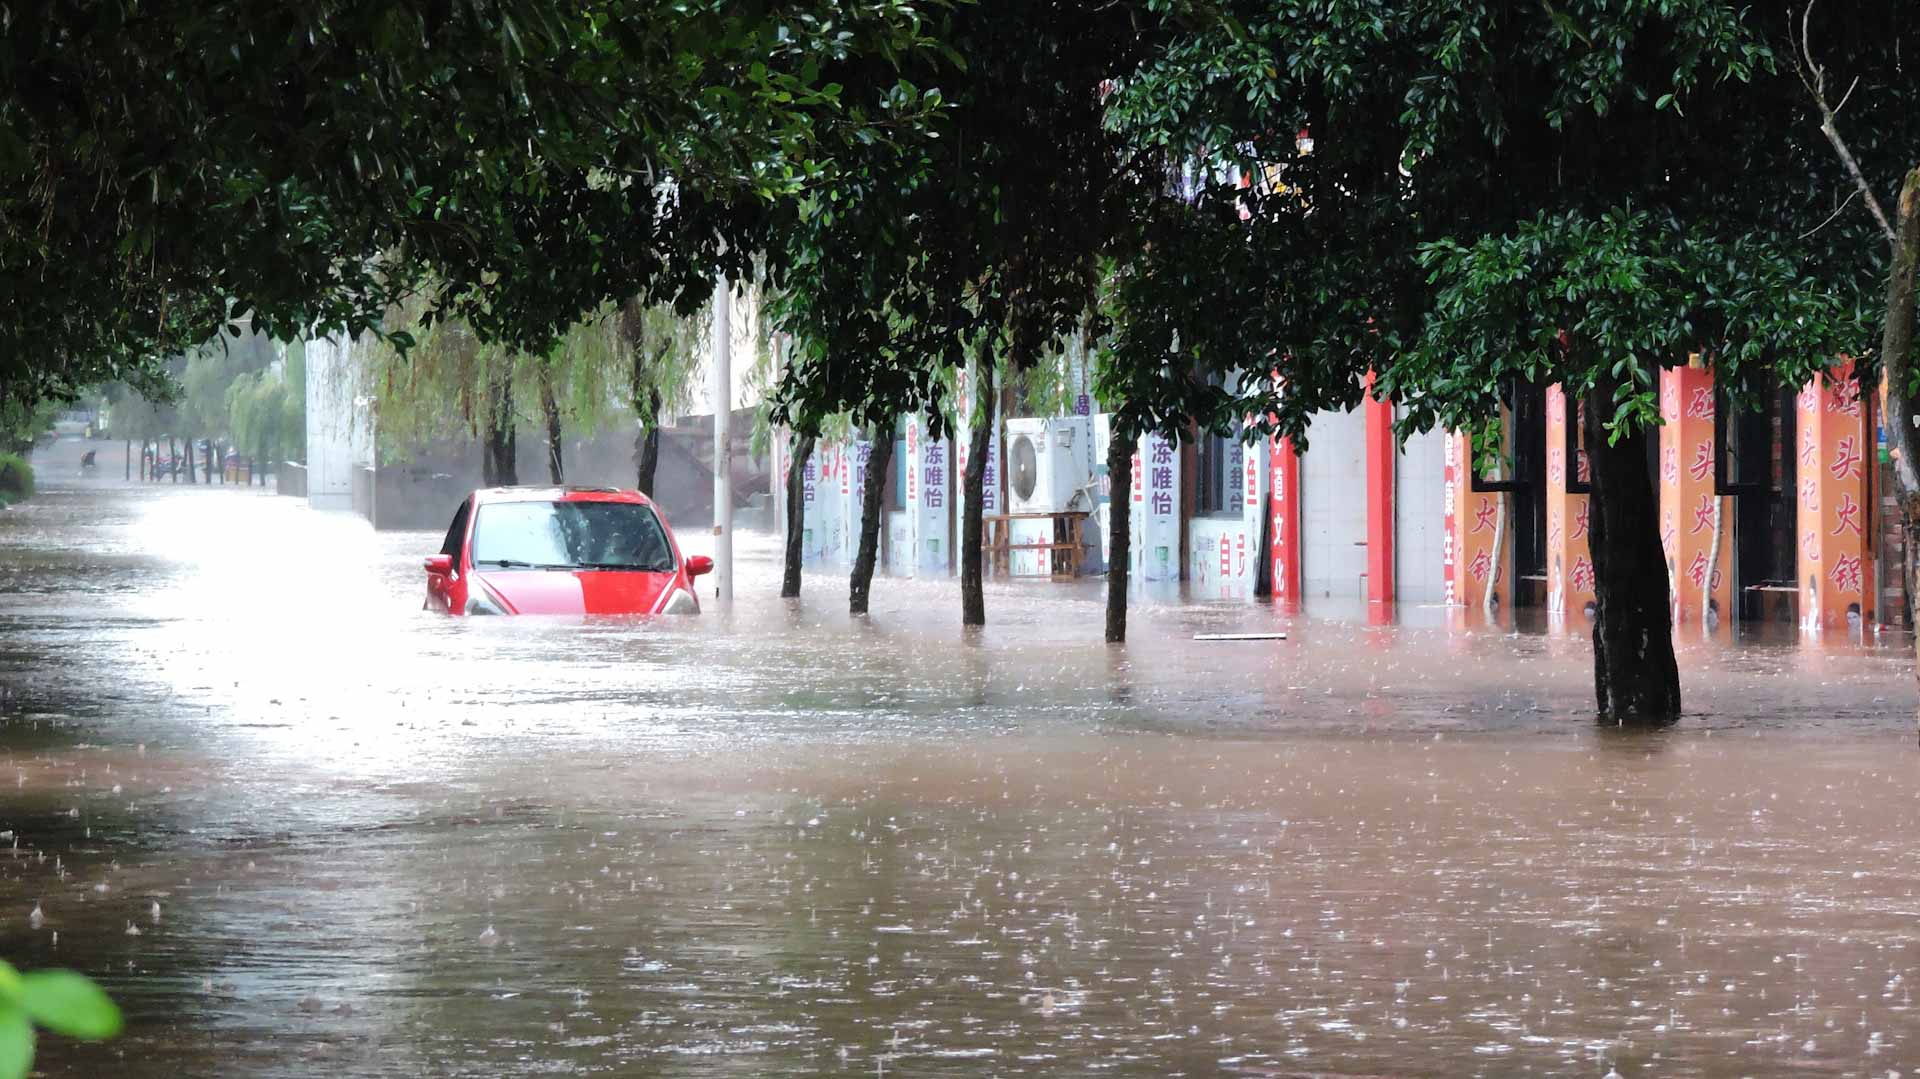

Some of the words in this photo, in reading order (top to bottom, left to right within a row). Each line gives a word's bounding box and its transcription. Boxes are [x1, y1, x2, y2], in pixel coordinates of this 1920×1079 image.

[924, 443, 944, 508] 冻唯怡
[1151, 430, 1173, 515] 冻唯怡
